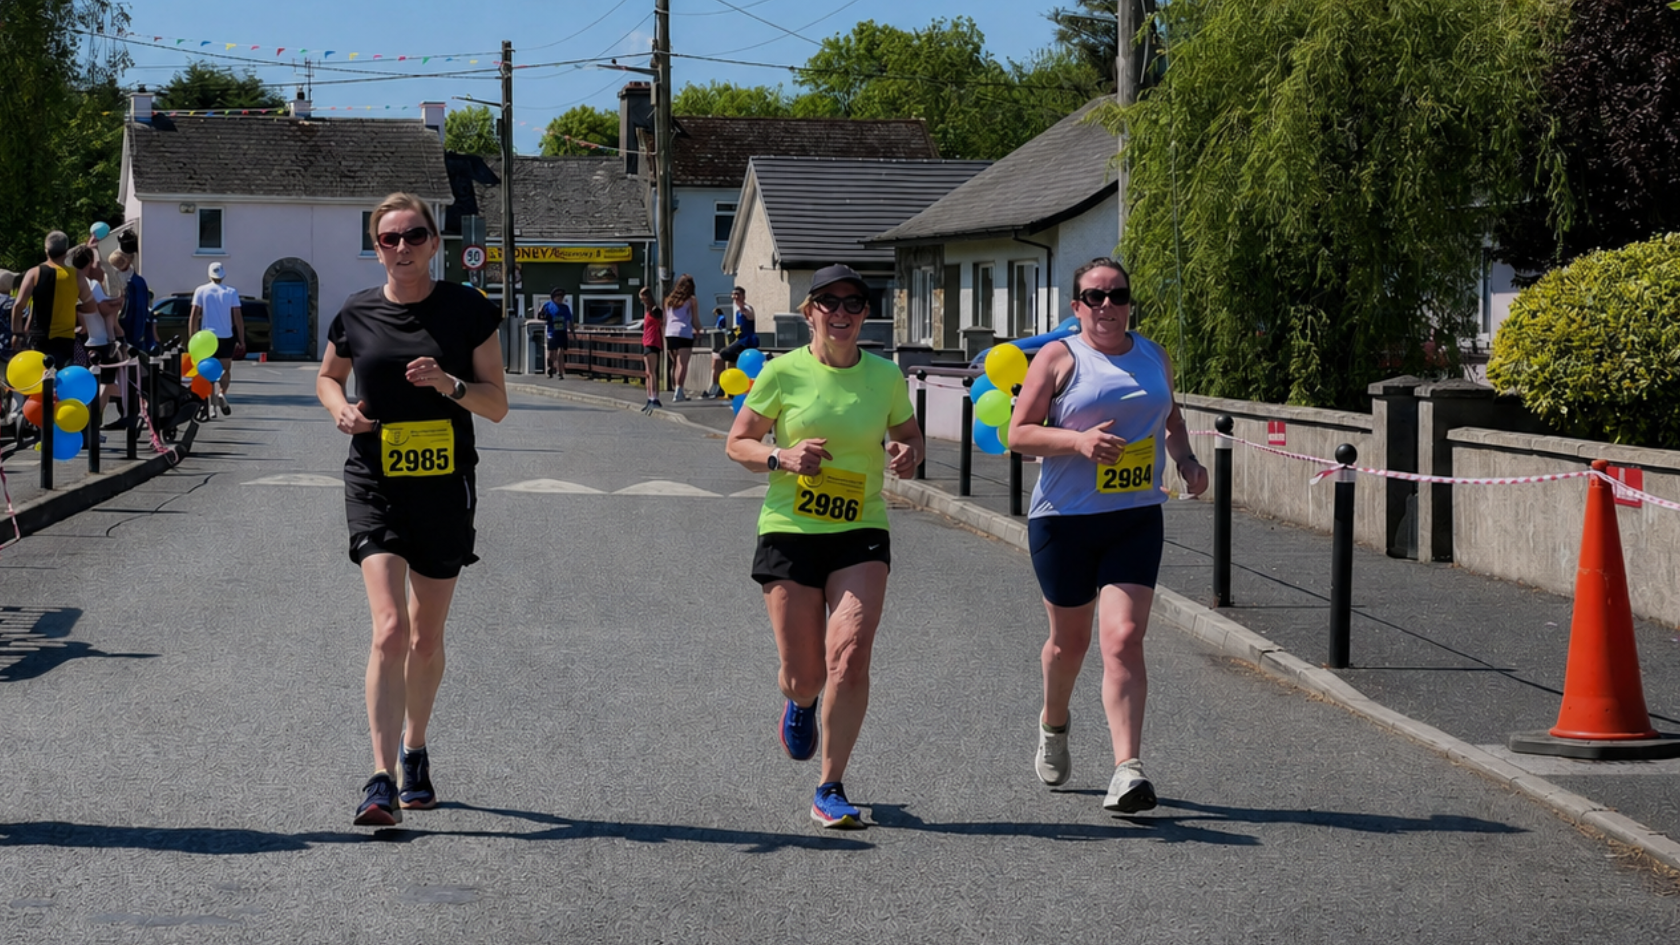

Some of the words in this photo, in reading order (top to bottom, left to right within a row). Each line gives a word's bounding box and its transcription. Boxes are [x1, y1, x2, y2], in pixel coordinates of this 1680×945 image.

[388, 448, 450, 472] 2985
[1102, 463, 1152, 489] 2984
[797, 489, 859, 522] 2986
